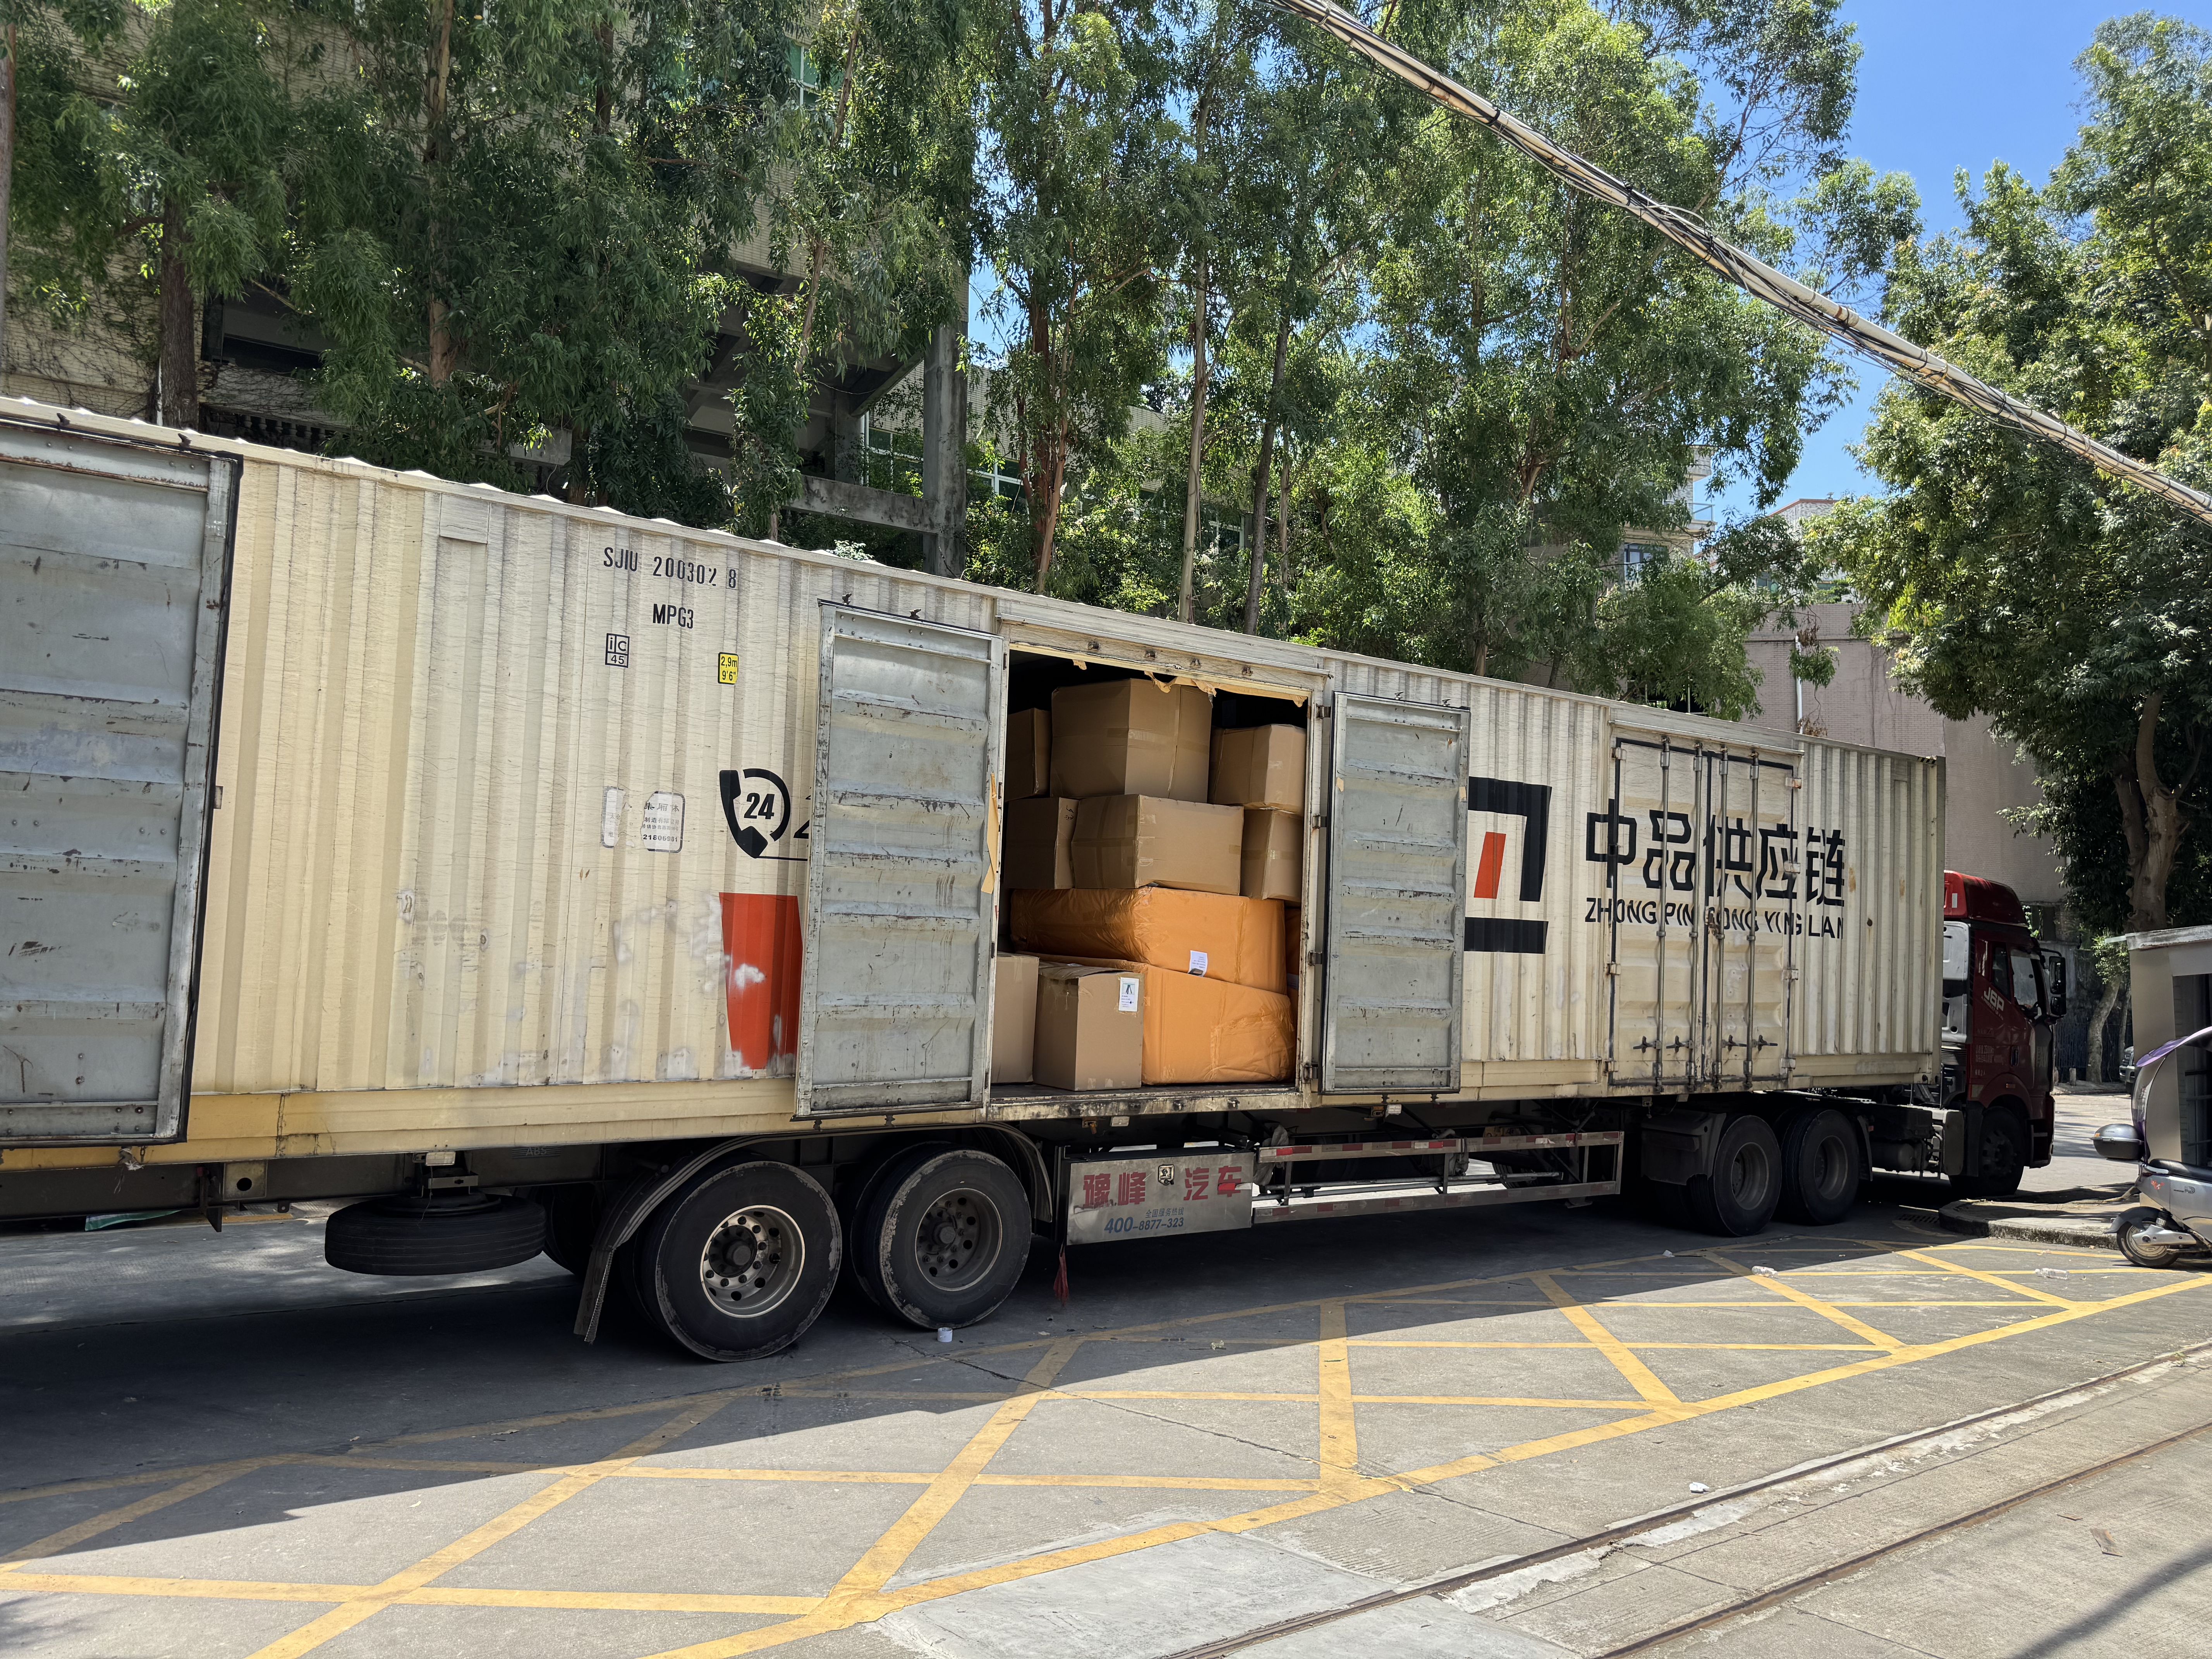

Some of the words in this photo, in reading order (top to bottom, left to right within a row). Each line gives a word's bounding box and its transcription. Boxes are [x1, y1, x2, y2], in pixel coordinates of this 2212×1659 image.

[653, 603, 694, 629] MPG3
[611, 654, 624, 665] 45
[721, 656, 737, 668] 2,9m
[744, 792, 775, 819] 24
[1585, 897, 1657, 924] ZHONG
[1665, 902, 1695, 926] PIN
[526, 1147, 547, 1156] ABS
[1145, 1207, 1184, 1218] 全国服务热线
[1104, 1216, 1184, 1233] 400-8877-323
